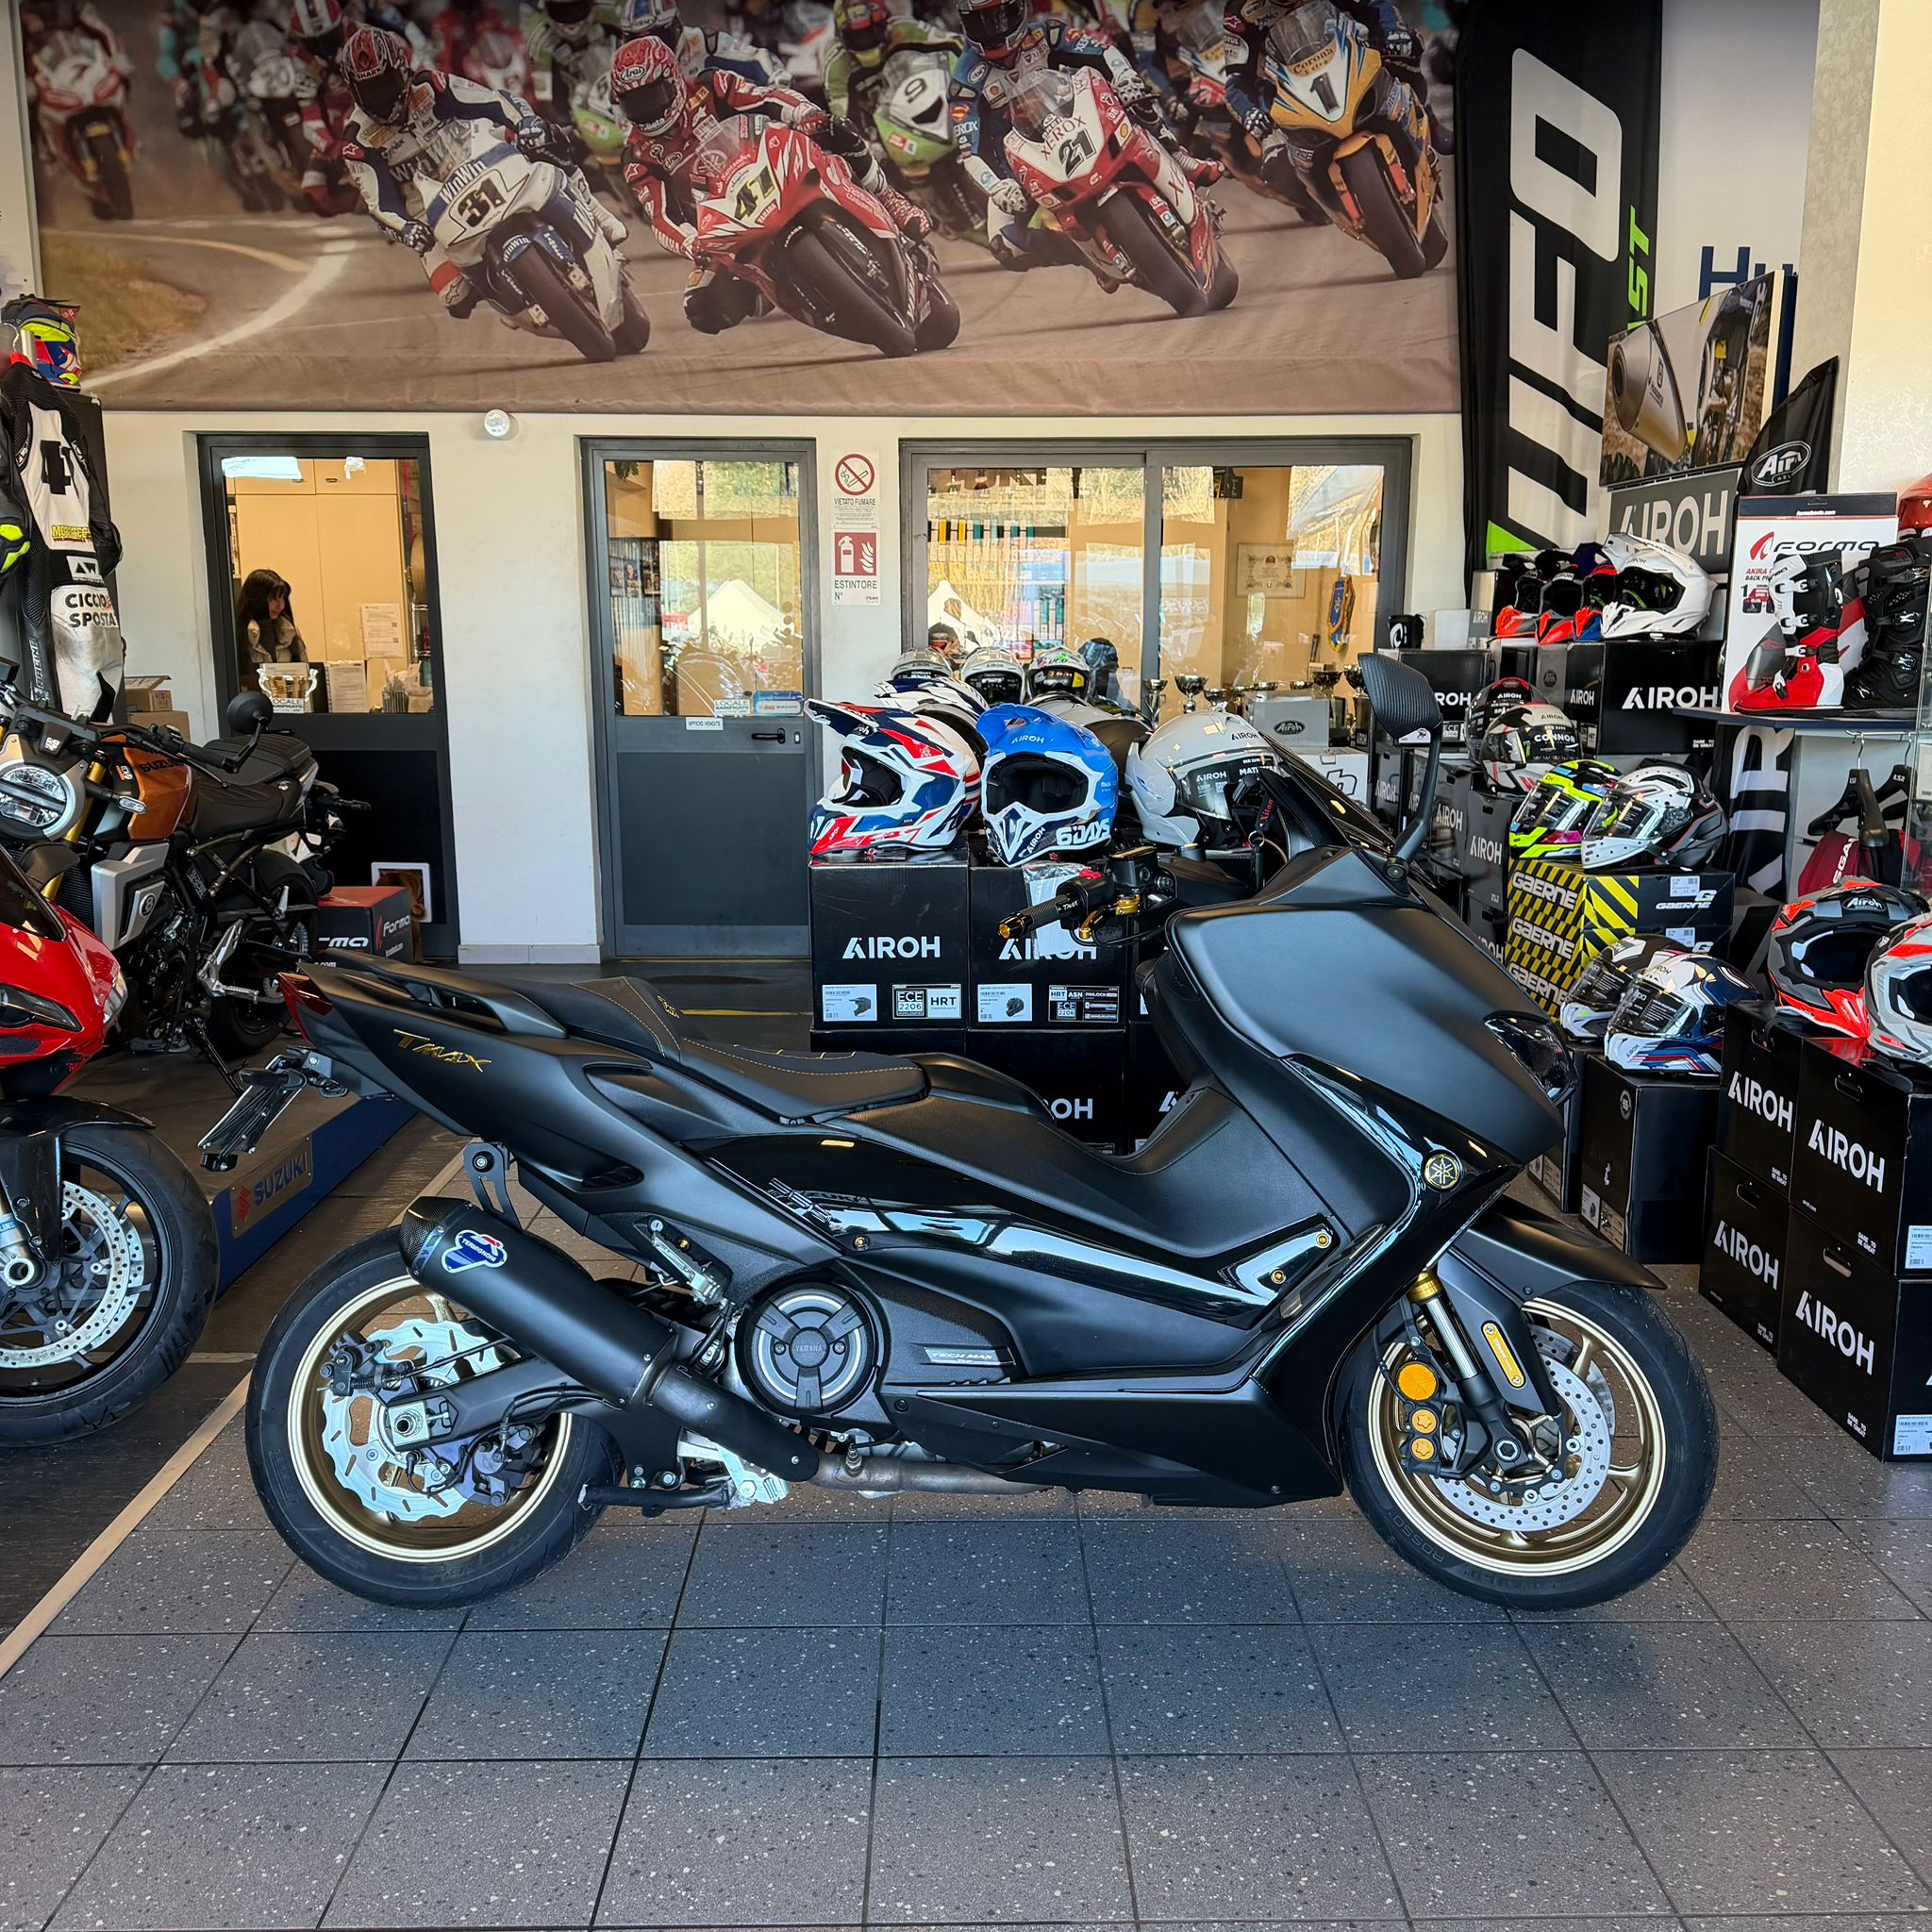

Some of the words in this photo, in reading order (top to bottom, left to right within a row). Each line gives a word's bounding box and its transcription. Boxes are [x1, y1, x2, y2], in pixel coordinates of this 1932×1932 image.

[622, 66, 644, 80] Arai
[1292, 47, 1335, 75] Corona
[1309, 73, 1341, 114] 1
[953, 120, 979, 137] EROX
[1041, 115, 1087, 161] XEROX
[1058, 128, 1097, 178] 21
[721, 154, 752, 180] Santander
[439, 159, 487, 205] WinWin
[735, 165, 775, 221] 41
[458, 177, 507, 227] 31
[757, 199, 777, 225] YAMAHA
[481, 210, 502, 227] HONDA
[1627, 206, 1649, 330] ST
[834, 580, 877, 590] ESTINTORE
[65, 593, 106, 608] CICCIO
[1435, 692, 1472, 706] ROH
[1570, 689, 1595, 706] AIROH
[1623, 687, 1719, 709] AIROH
[1011, 735, 1045, 743] AIROH
[1277, 722, 1304, 732] Airoh
[1534, 734, 1575, 743] CONNOR
[1196, 771, 1227, 783] AIROH
[1892, 774, 1907, 782] LS2
[1436, 803, 1463, 831] AIROH
[1026, 826, 1046, 855] AIROH
[1470, 835, 1503, 865] AIROH
[1847, 897, 1883, 908] Airoh
[841, 936, 941, 959] AIROH
[898, 991, 923, 1002] ECE
[930, 996, 957, 1006] HRT
[1625, 1043, 1640, 1058] AIROH
[1727, 1071, 1794, 1133] AIROH
[1807, 1119, 1886, 1193] AIROH
[253, 1151, 308, 1207] SUZUKI
[461, 1236, 498, 1262] TERMIGNONI
[1713, 1220, 1779, 1291] AIROH
[1794, 1290, 1875, 1375] AIROH
[795, 1344, 824, 1353] YAMAHA
[1392, 1514, 1446, 1563] ROSSO
